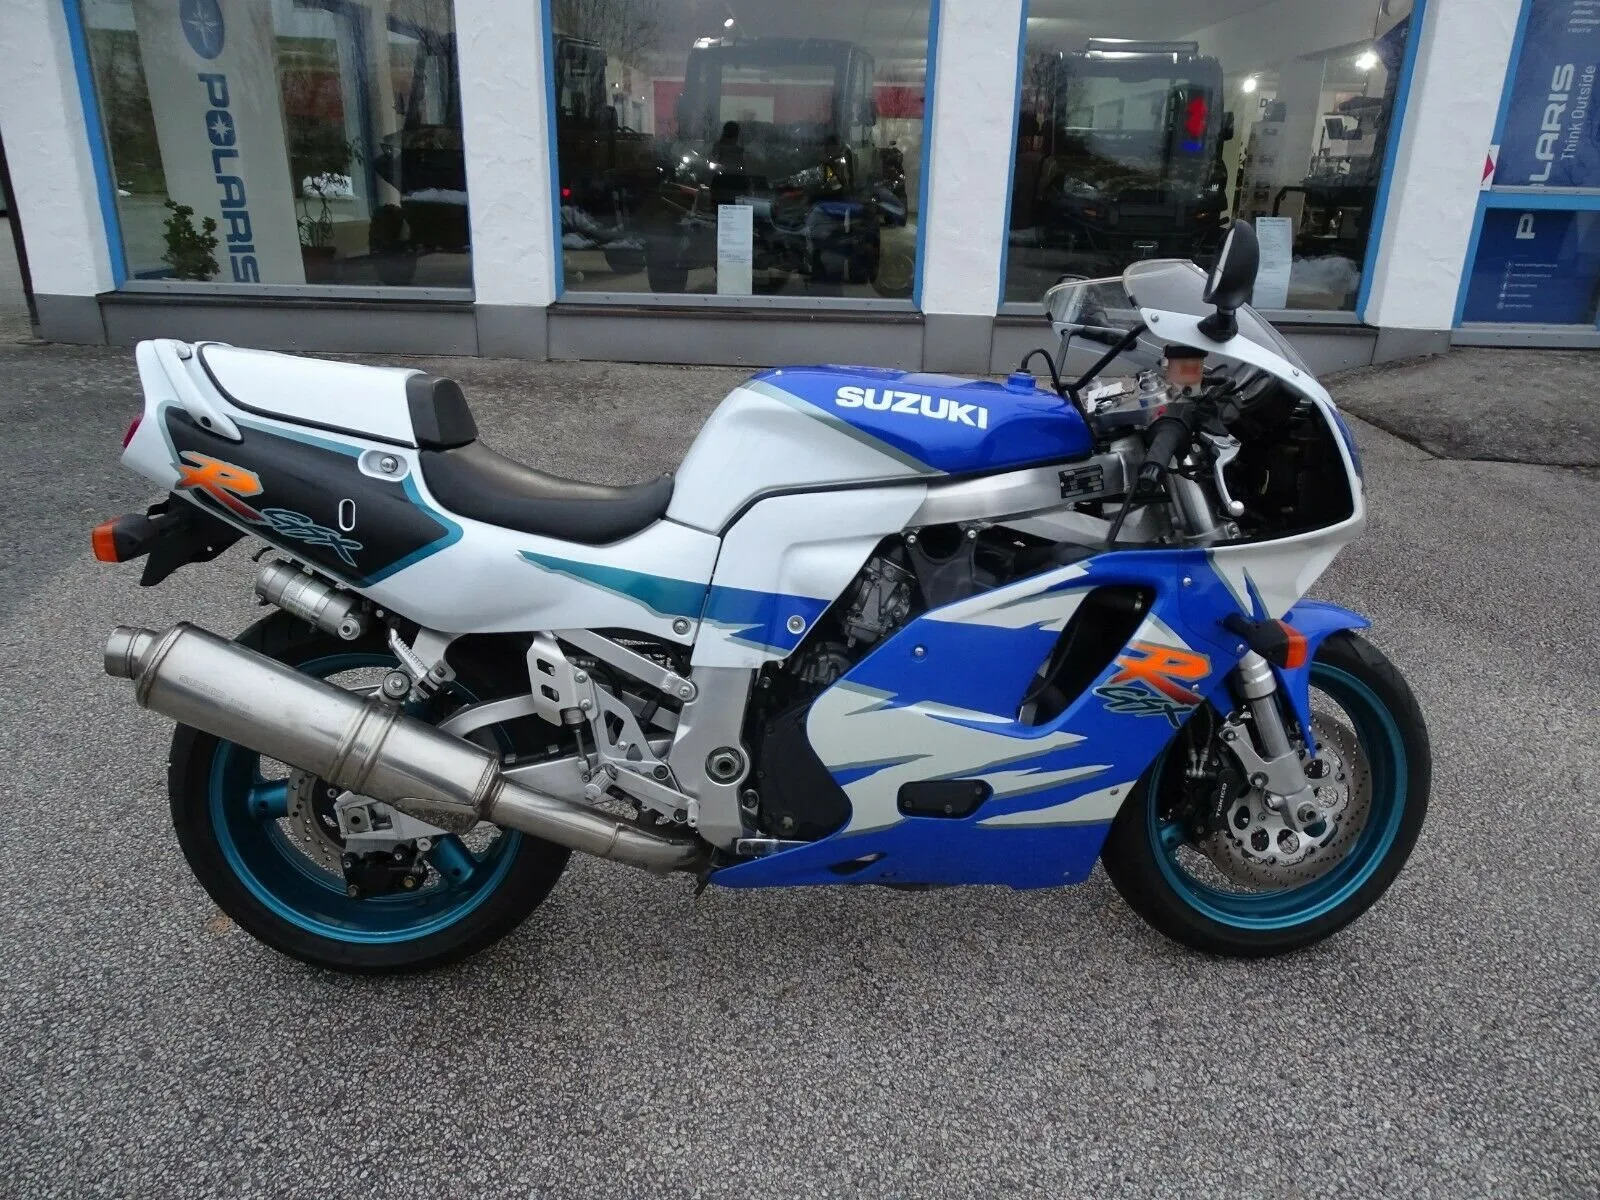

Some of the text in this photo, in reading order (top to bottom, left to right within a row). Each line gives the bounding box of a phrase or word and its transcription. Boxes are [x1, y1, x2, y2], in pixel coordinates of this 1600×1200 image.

[1560, 65, 1596, 160] Think Outside
[197, 73, 260, 283] POLARIS
[835, 386, 988, 430] SUZUKI
[1215, 782, 1228, 818] TOKICO
